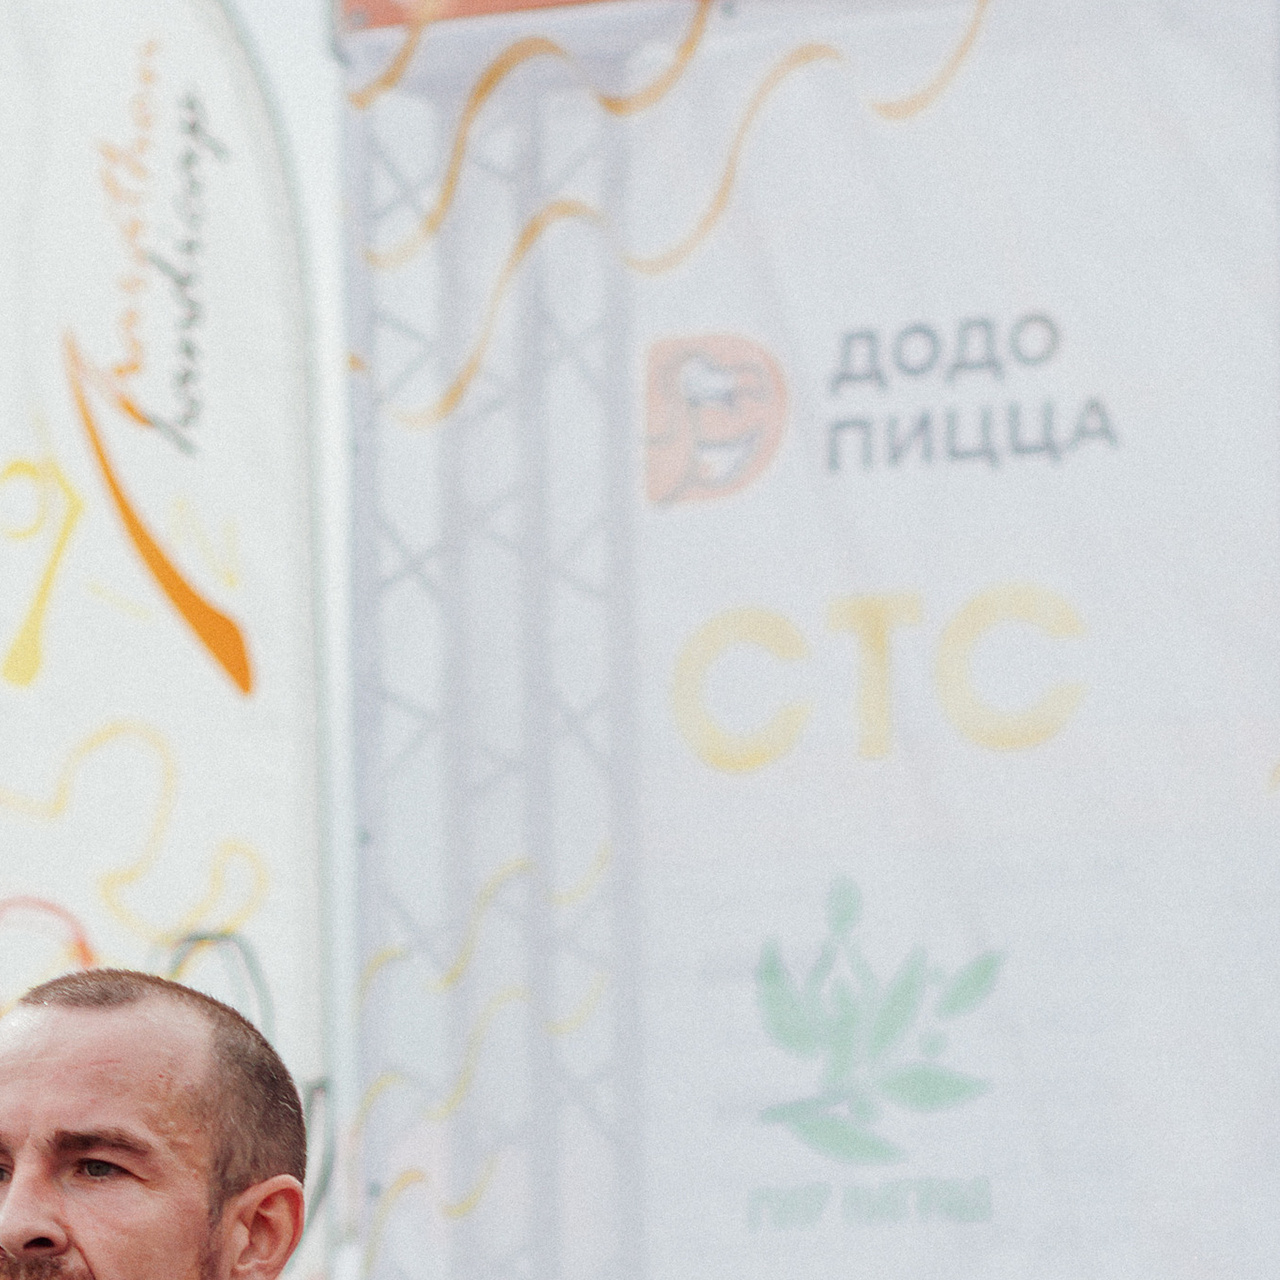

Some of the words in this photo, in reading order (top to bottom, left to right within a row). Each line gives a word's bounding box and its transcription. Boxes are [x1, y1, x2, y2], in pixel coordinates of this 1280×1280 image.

[826, 311, 1064, 394] ДОДО
[826, 395, 1120, 471] ПИЦЦА
[671, 579, 1088, 774] СТС
